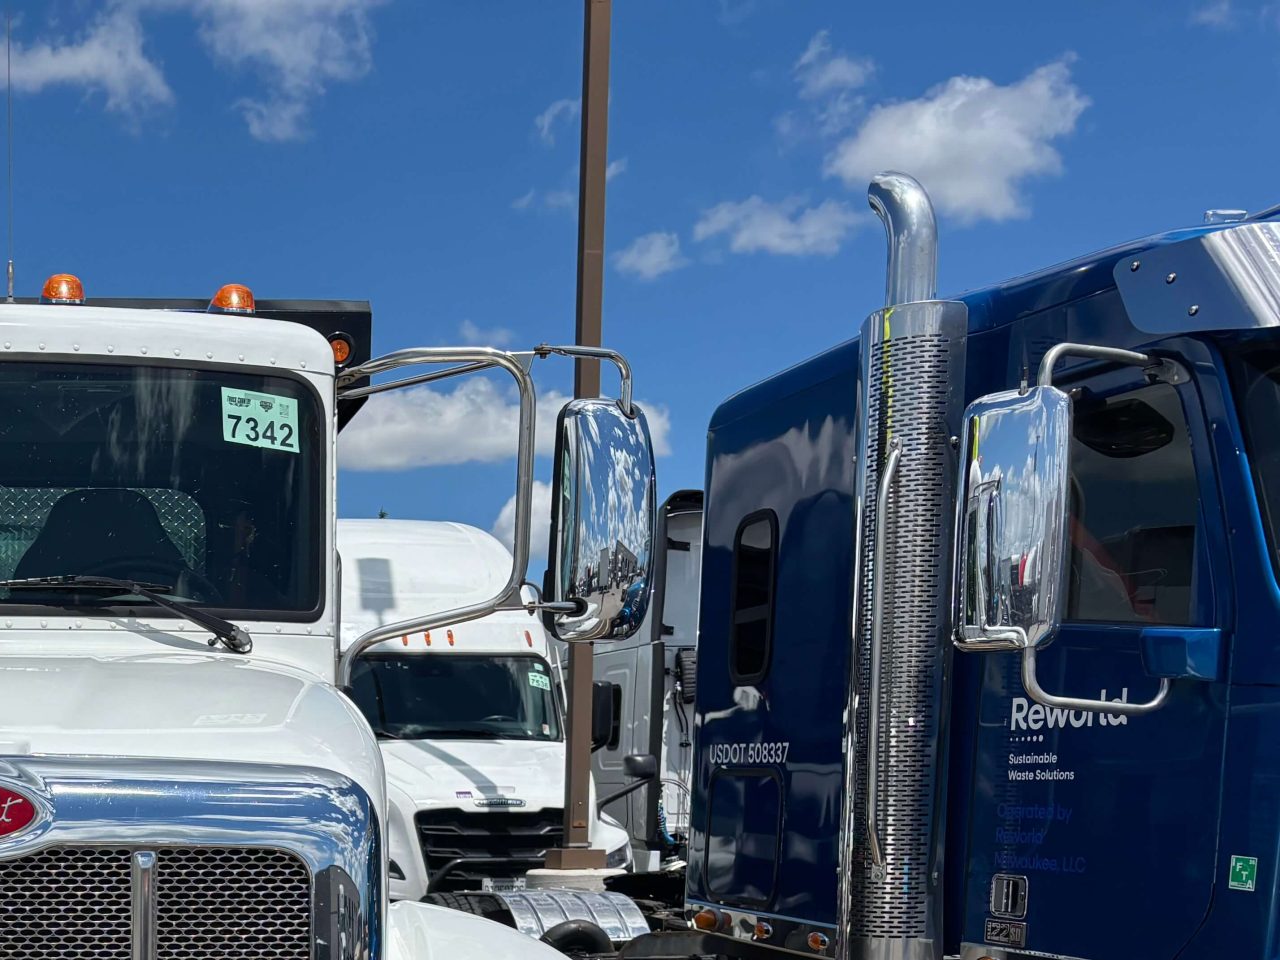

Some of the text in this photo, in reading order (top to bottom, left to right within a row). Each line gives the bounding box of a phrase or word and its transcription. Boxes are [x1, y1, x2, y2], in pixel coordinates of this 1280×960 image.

[227, 414, 294, 448] 7342
[709, 742, 790, 764] USDOT 508337
[1008, 752, 1058, 764] Sustainable
[1008, 769, 1075, 780] Waste Solutions
[1057, 803, 1073, 824] by
[1062, 856, 1086, 873] LLC
